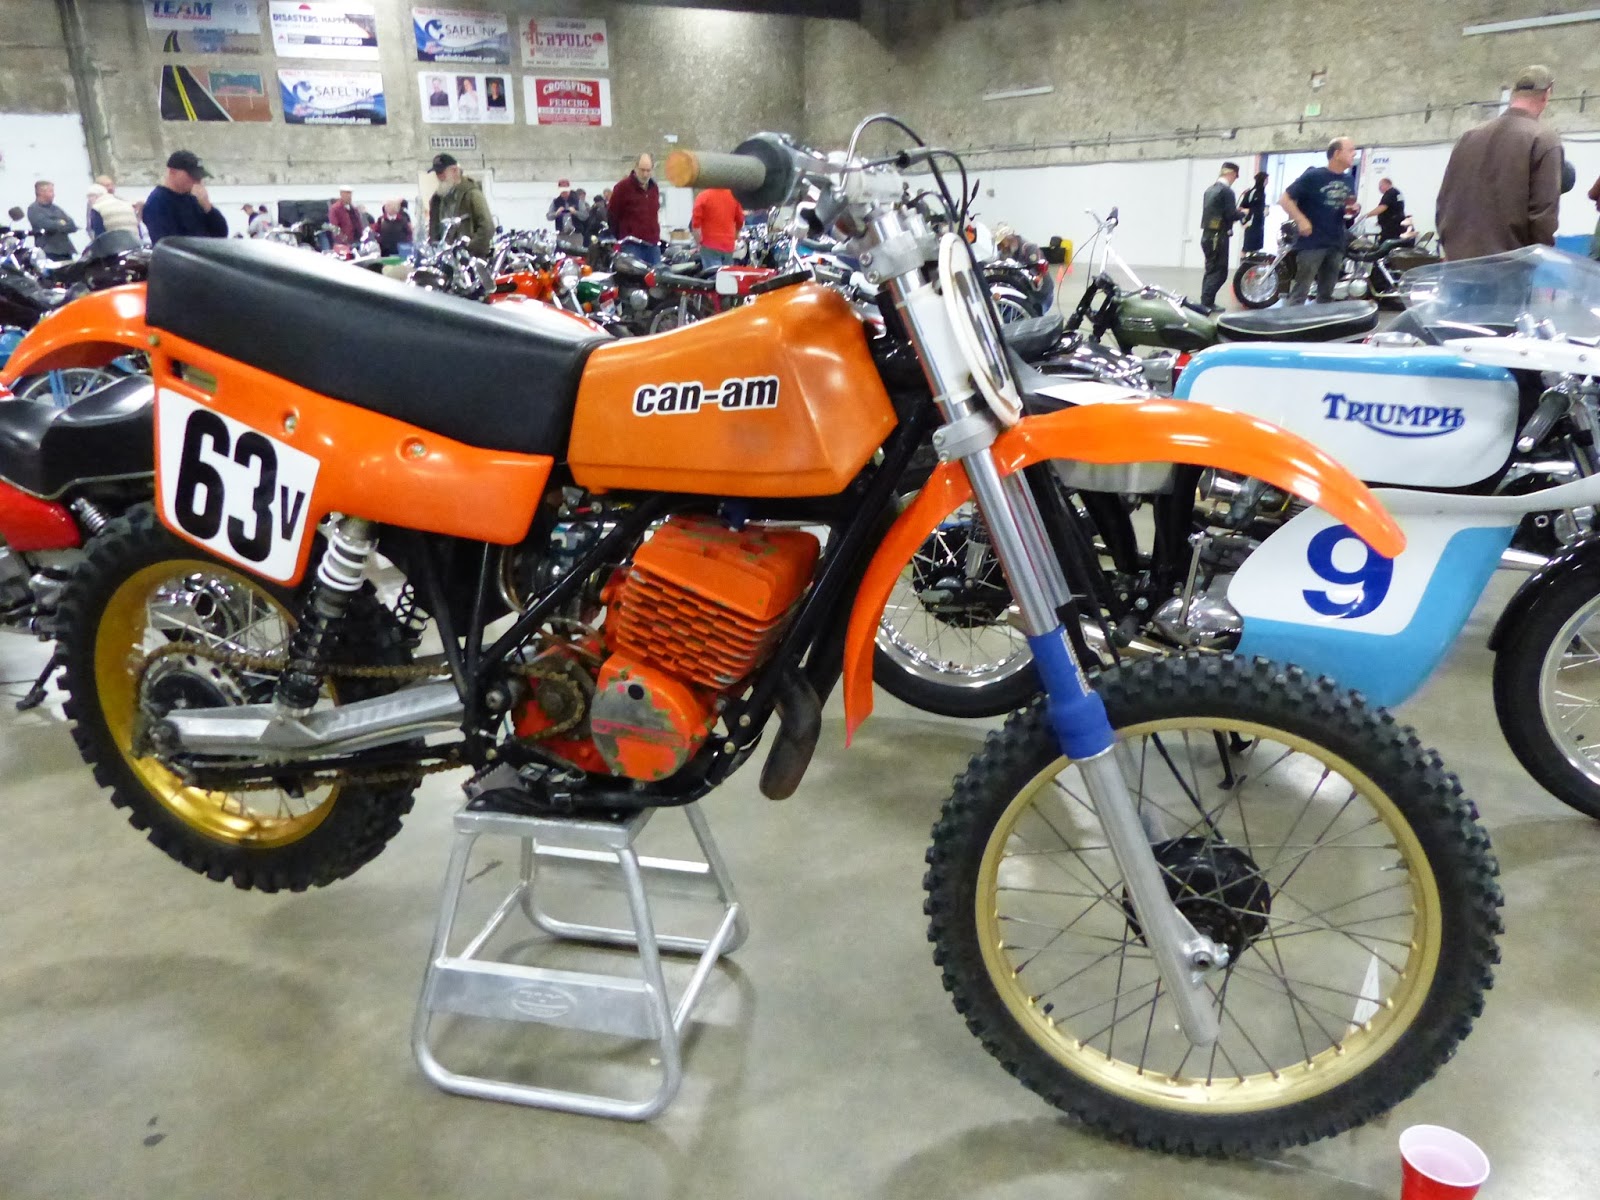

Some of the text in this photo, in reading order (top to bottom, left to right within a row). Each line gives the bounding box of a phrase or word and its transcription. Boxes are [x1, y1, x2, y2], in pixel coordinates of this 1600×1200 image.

[445, 23, 497, 37] SAFELNK
[314, 85, 372, 98] SAFELNK
[542, 79, 593, 97] CROSSFIRE
[549, 98, 590, 108] FENCING
[431, 137, 475, 148] RESTROOMS
[634, 377, 779, 415] can-am
[1302, 523, 1395, 620] 9
